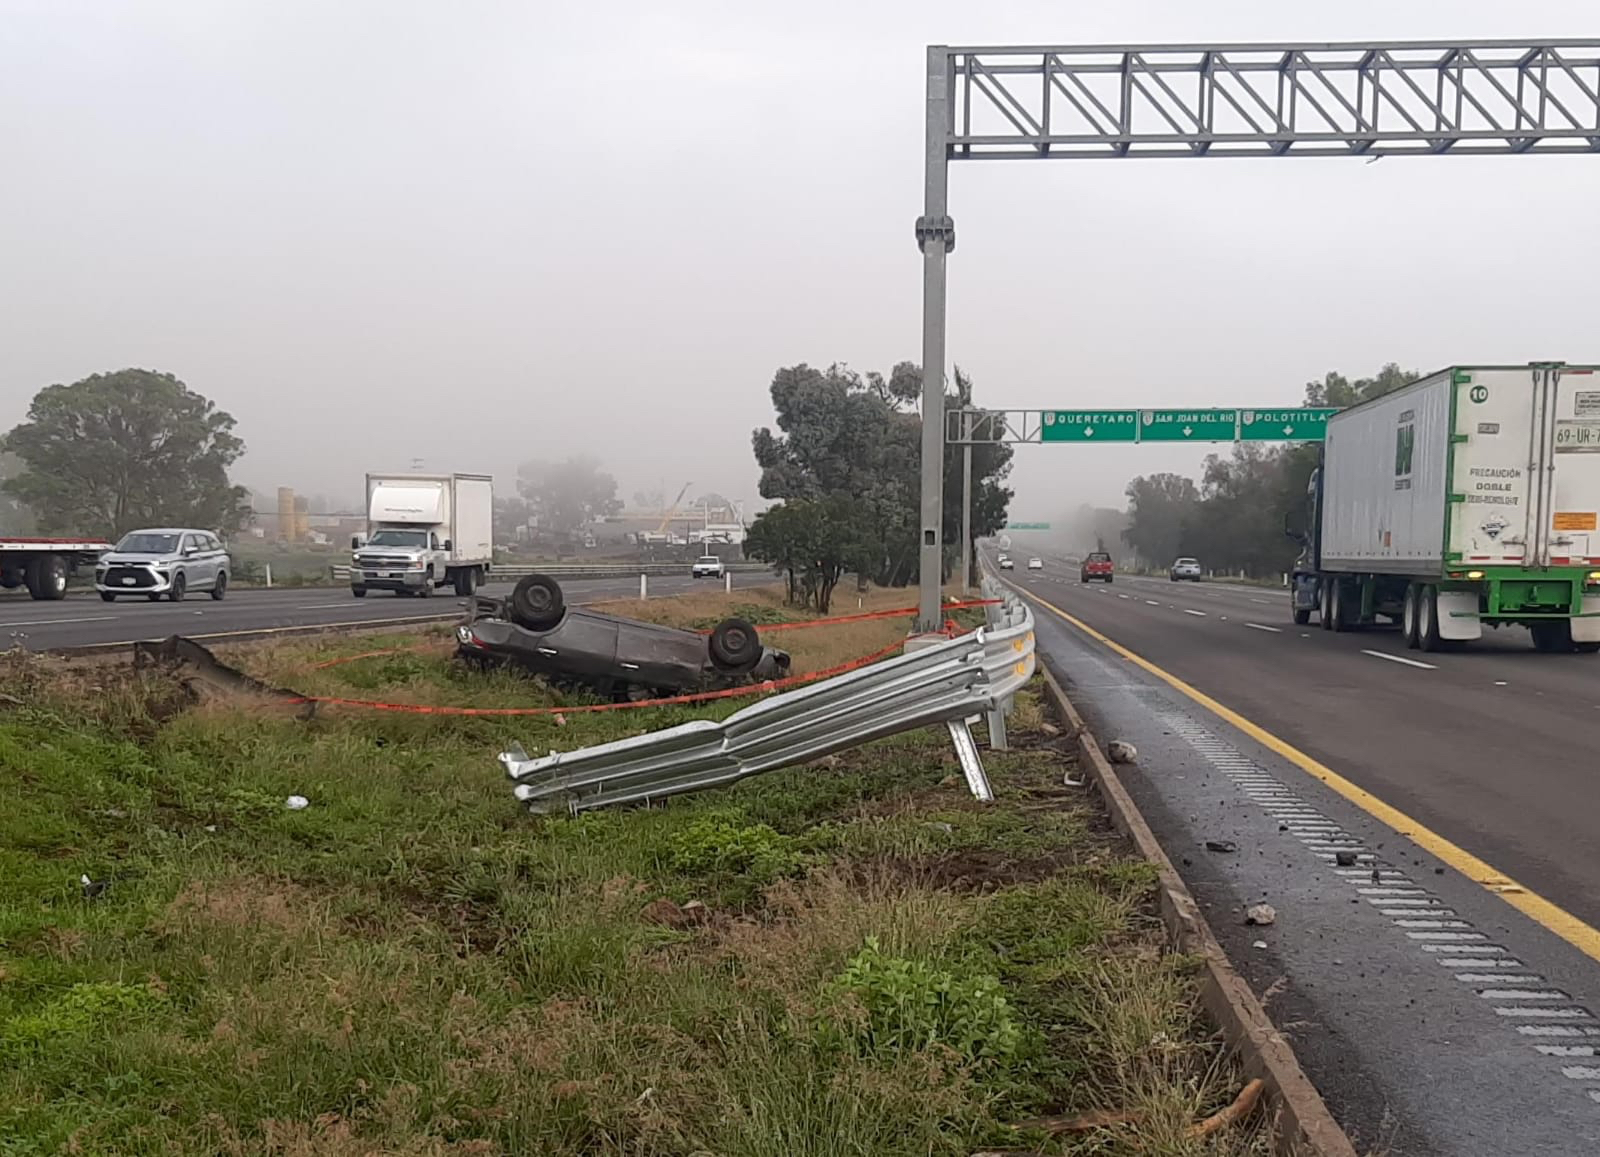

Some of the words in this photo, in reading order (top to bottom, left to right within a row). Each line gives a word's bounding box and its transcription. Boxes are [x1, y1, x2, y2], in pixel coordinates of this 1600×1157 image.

[1472, 388, 1488, 401] 10
[1058, 414, 1134, 424] QUERETARO
[1155, 414, 1174, 423] SAN
[1176, 413, 1199, 423] JUAN
[1200, 413, 1217, 423] DEL
[1255, 412, 1328, 422] POLOTITLA
[1476, 482, 1512, 491] DOBLE
